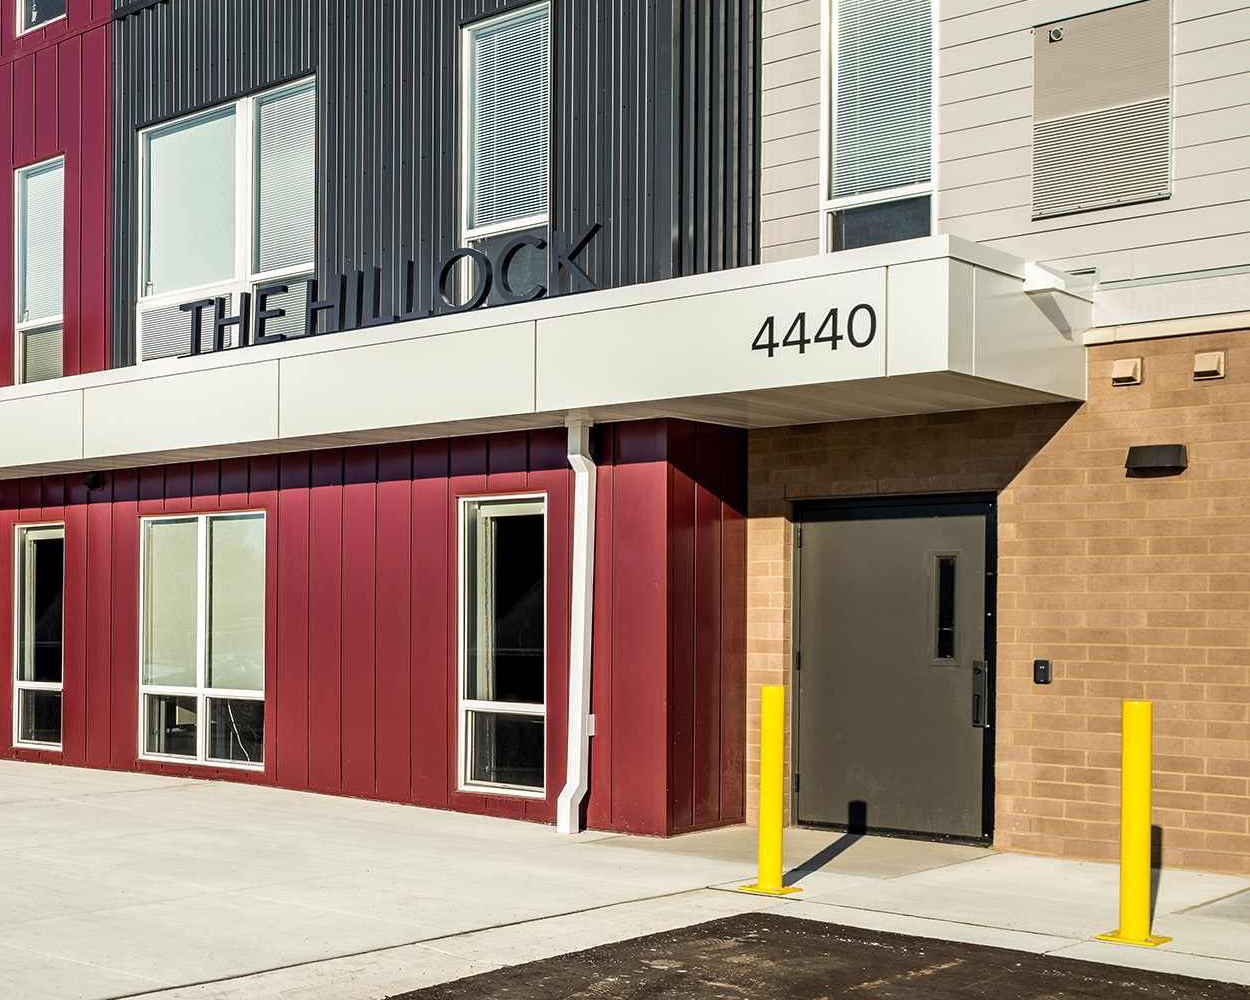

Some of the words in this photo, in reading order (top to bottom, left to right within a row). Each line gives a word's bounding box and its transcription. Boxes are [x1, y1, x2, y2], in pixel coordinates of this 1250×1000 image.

[180, 285, 288, 356] THE
[305, 222, 603, 337] HILLOCK
[751, 303, 877, 358] 4440
